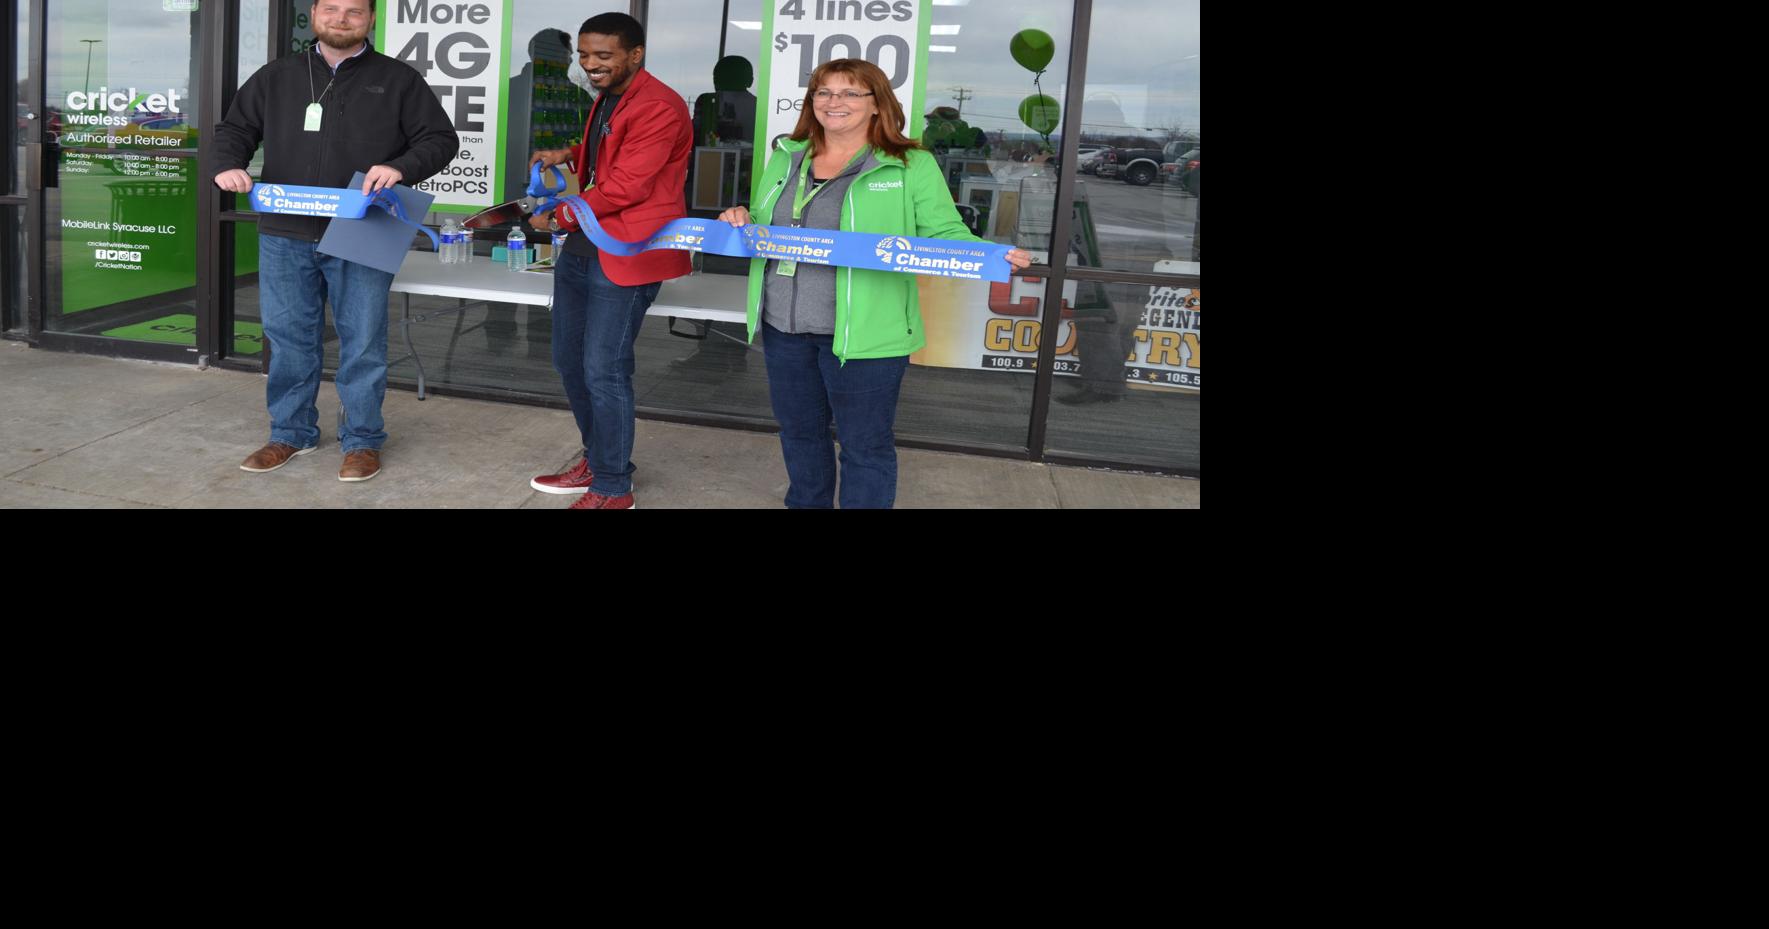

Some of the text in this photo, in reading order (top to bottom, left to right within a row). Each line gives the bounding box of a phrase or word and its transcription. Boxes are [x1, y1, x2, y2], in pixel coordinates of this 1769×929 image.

[397, 0, 491, 24] More
[780, 0, 913, 21] 4 lines
[396, 31, 491, 79] 4G
[67, 86, 180, 113] cricket
[67, 112, 128, 126] wireless
[66, 132, 182, 146] Authorized Retailer
[462, 136, 484, 144] than
[441, 165, 489, 177] Boost
[274, 198, 339, 211] Chamber
[62, 219, 176, 235] MobileLink Syracuse LLC
[87, 241, 150, 250] cricketwireless.com
[756, 240, 832, 258] Chamber
[914, 245, 946, 253] LIVINGSTON
[895, 253, 984, 271] Chamber
[950, 271, 982, 279] Tourism
[991, 357, 1024, 368] 100.9
[1053, 361, 1080, 372] 03.7
[1166, 372, 1200, 385] 105.5
